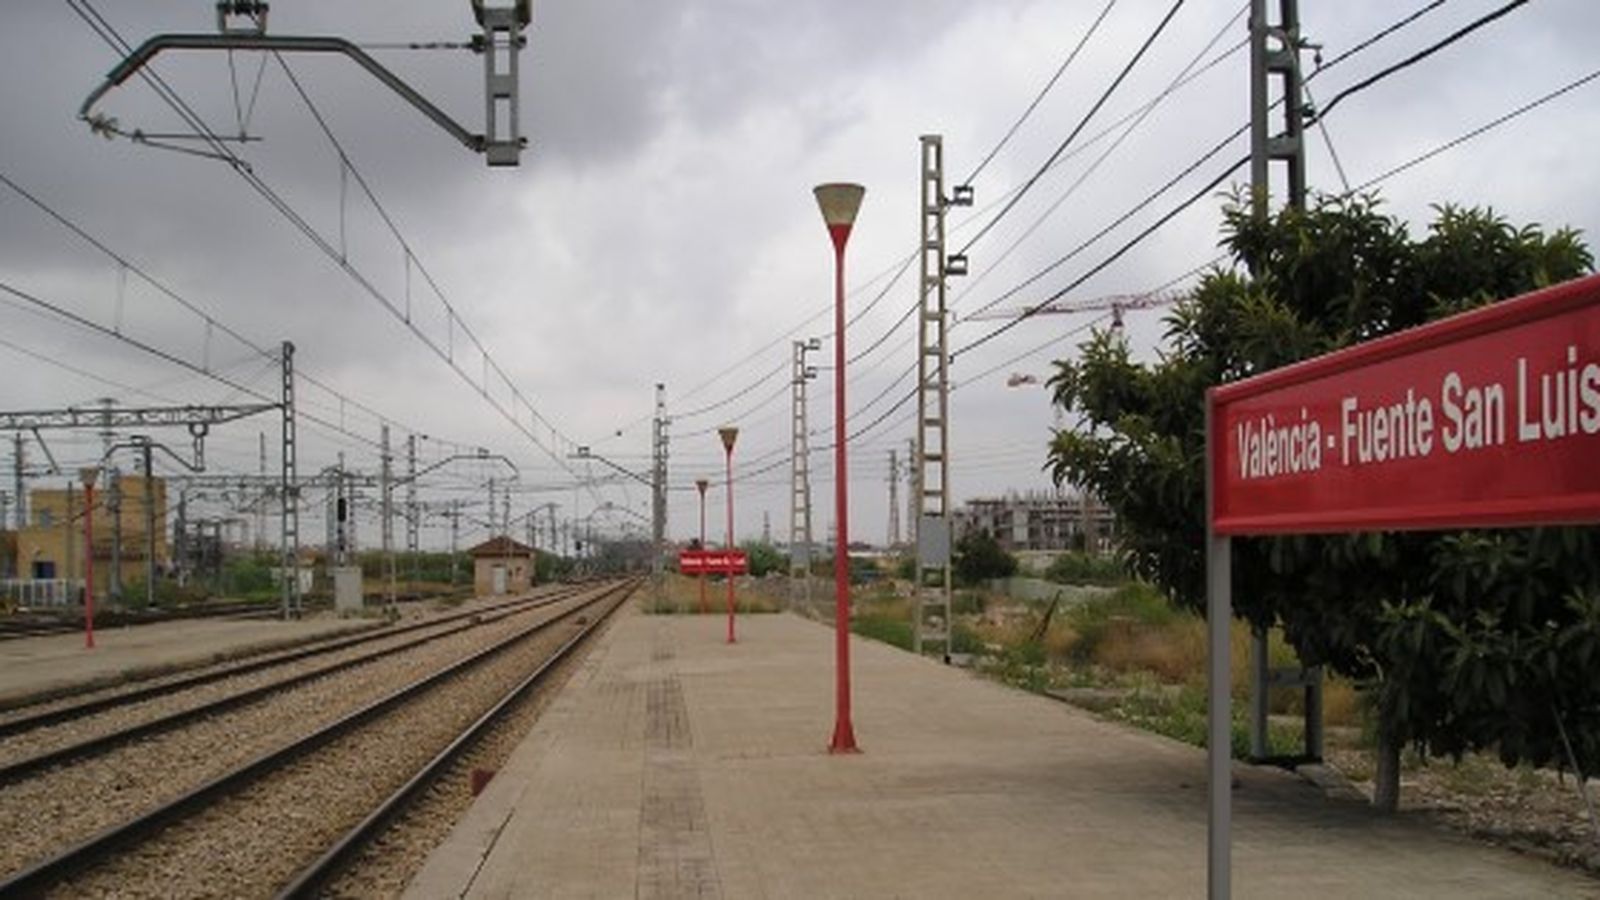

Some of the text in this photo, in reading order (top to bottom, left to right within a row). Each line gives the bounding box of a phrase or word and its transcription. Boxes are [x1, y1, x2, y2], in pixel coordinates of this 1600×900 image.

[1237, 346, 1600, 479] València - Fuente San Luis
